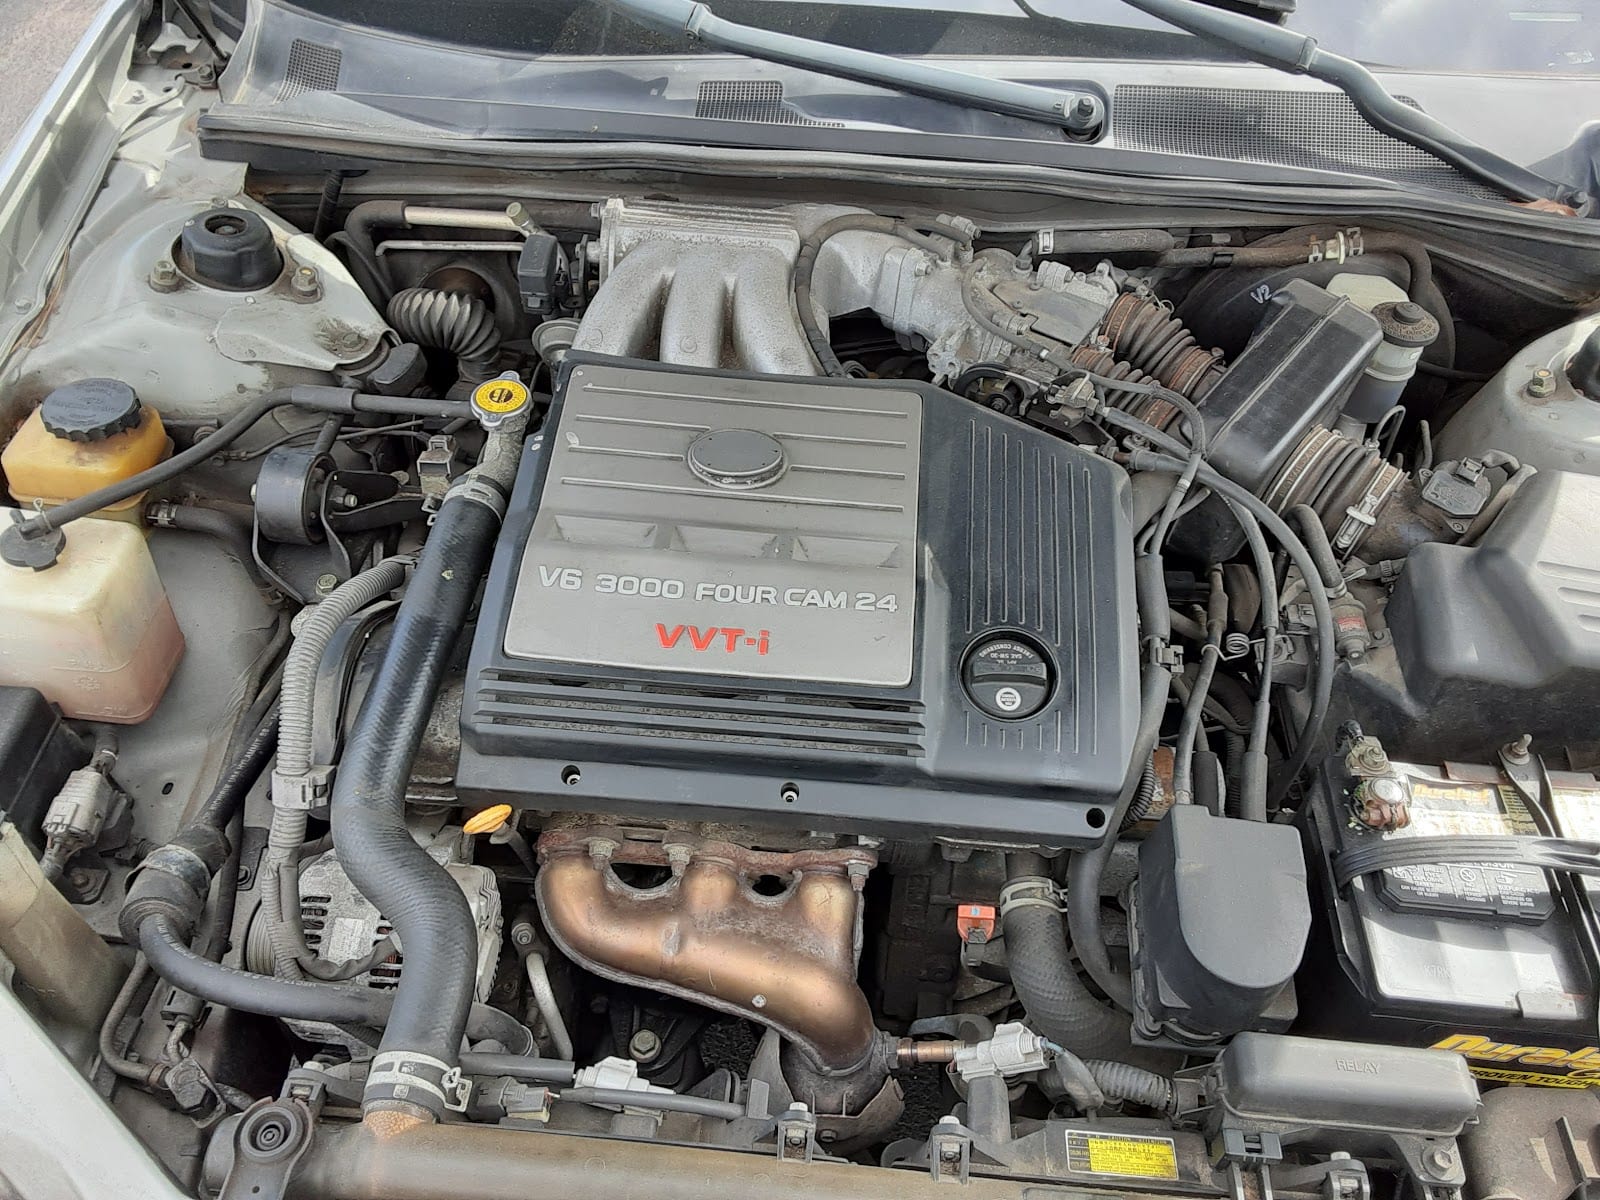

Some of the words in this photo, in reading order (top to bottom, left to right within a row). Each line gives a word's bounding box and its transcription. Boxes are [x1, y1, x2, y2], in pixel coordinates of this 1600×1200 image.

[538, 565, 583, 591] V6
[595, 573, 684, 600] 3000
[695, 582, 777, 606] FOUR
[784, 588, 849, 610] CAM
[854, 592, 898, 613] 24
[655, 622, 771, 656] VVT-i
[979, 643, 1012, 657] CONSERVING
[1013, 645, 1034, 659] ENERGY
[1336, 1057, 1380, 1074] RELAY
